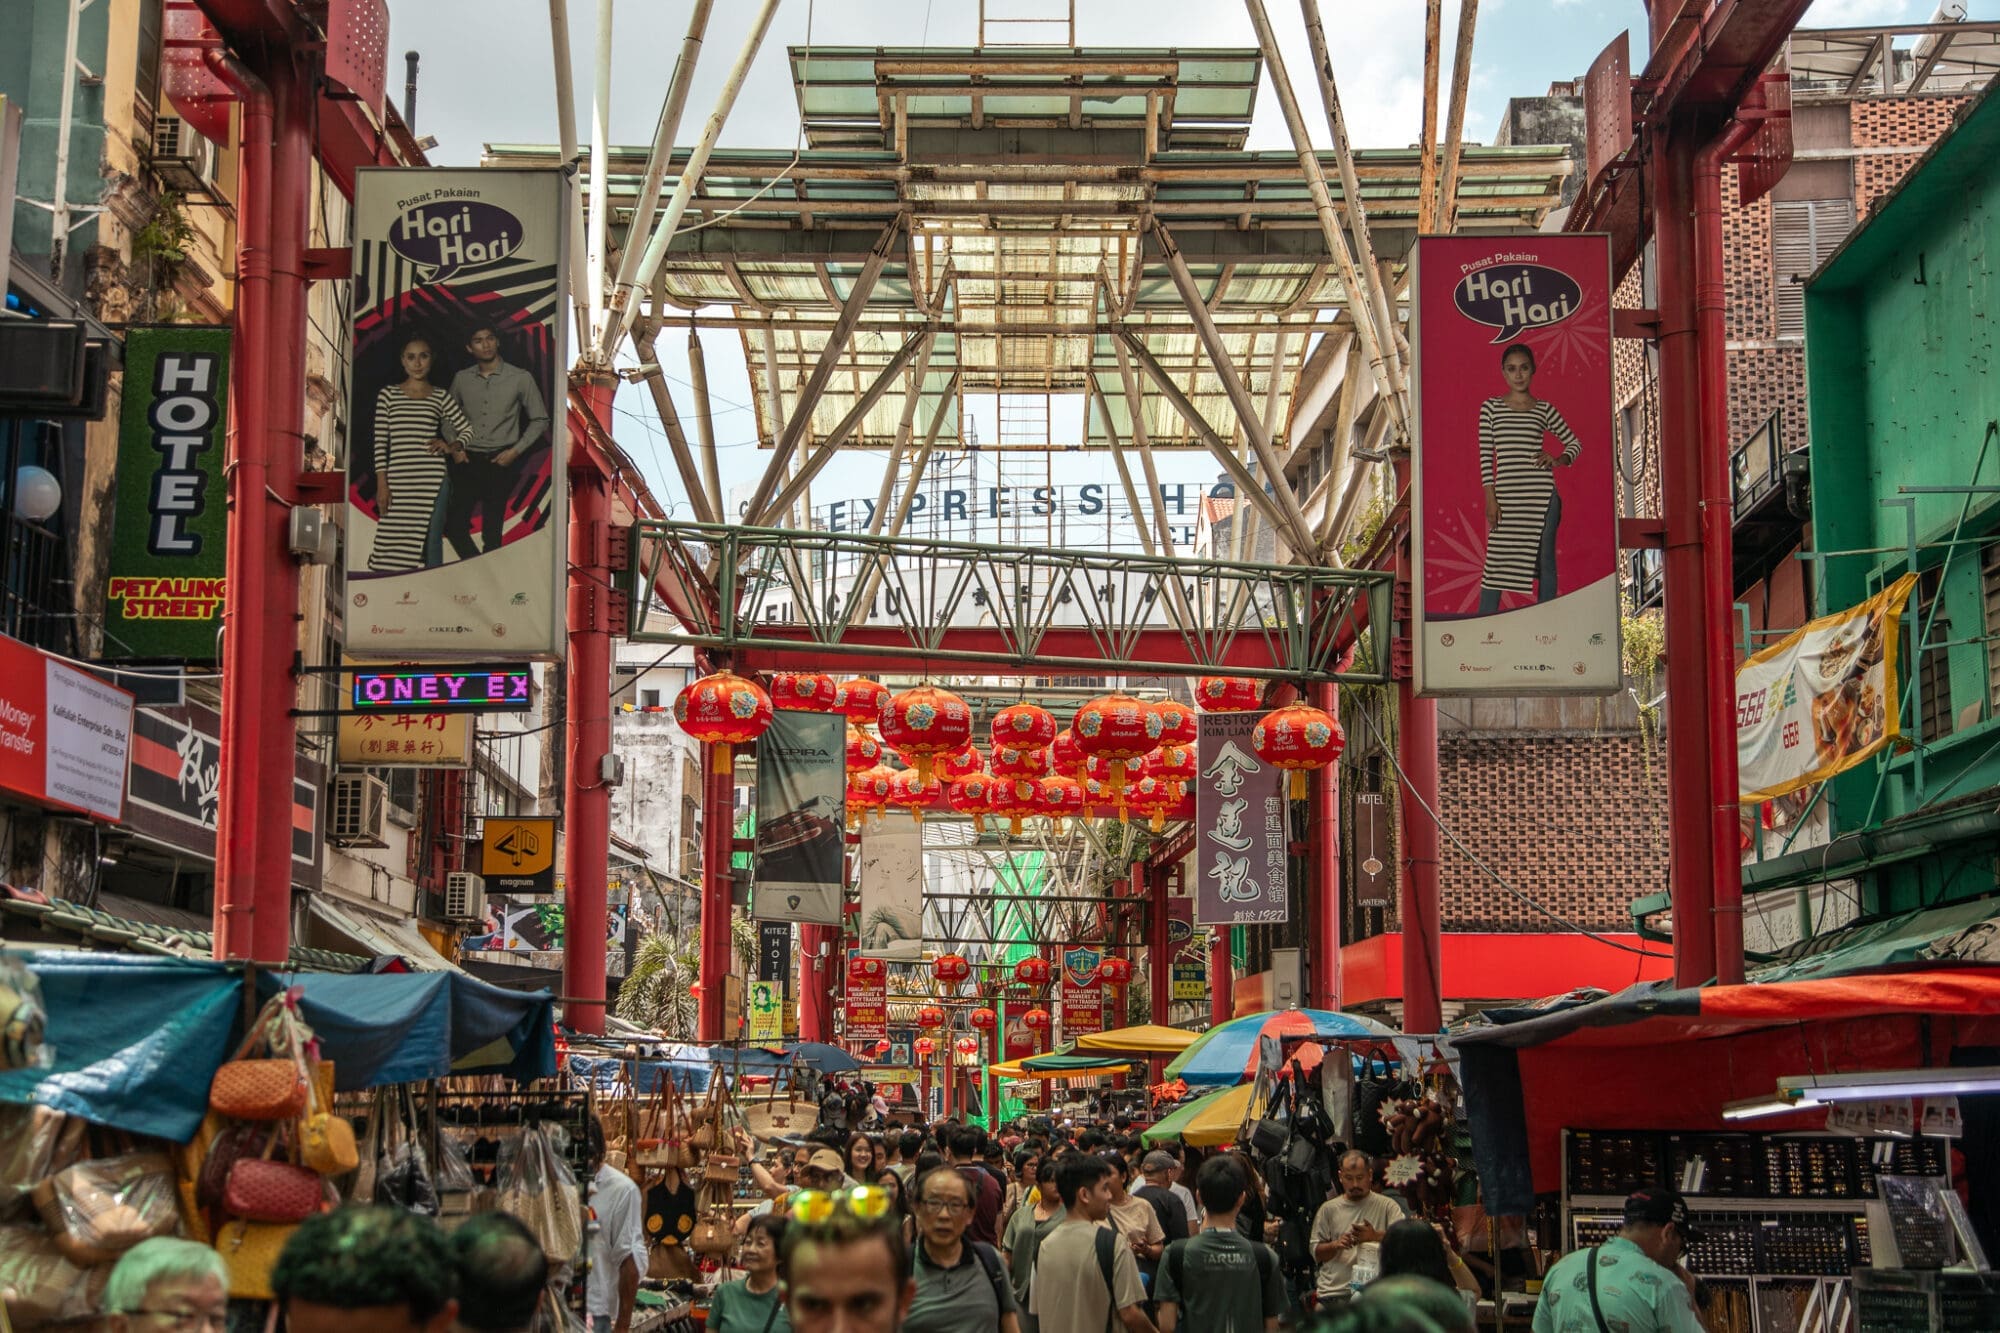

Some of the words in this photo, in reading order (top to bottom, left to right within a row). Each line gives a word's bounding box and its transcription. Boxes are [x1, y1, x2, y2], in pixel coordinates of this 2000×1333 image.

[397, 193, 432, 210] Pusat
[434, 188, 480, 199] Pakaian
[401, 206, 471, 240] Hari
[439, 231, 509, 266] Hari
[1460, 256, 1493, 274] Pusat
[1495, 253, 1538, 263] Pakaian
[1466, 269, 1532, 302] Hari
[1503, 293, 1569, 326] Hari
[156, 358, 211, 549] HOTEL
[829, 483, 1104, 533] EXPRESS
[123, 599, 217, 619] STREET
[365, 677, 466, 701] ONEY
[1204, 728, 1225, 737] KIM
[1358, 794, 1384, 804] HOTEL
[500, 879, 534, 887] magnum
[1258, 909, 1284, 920] 1927
